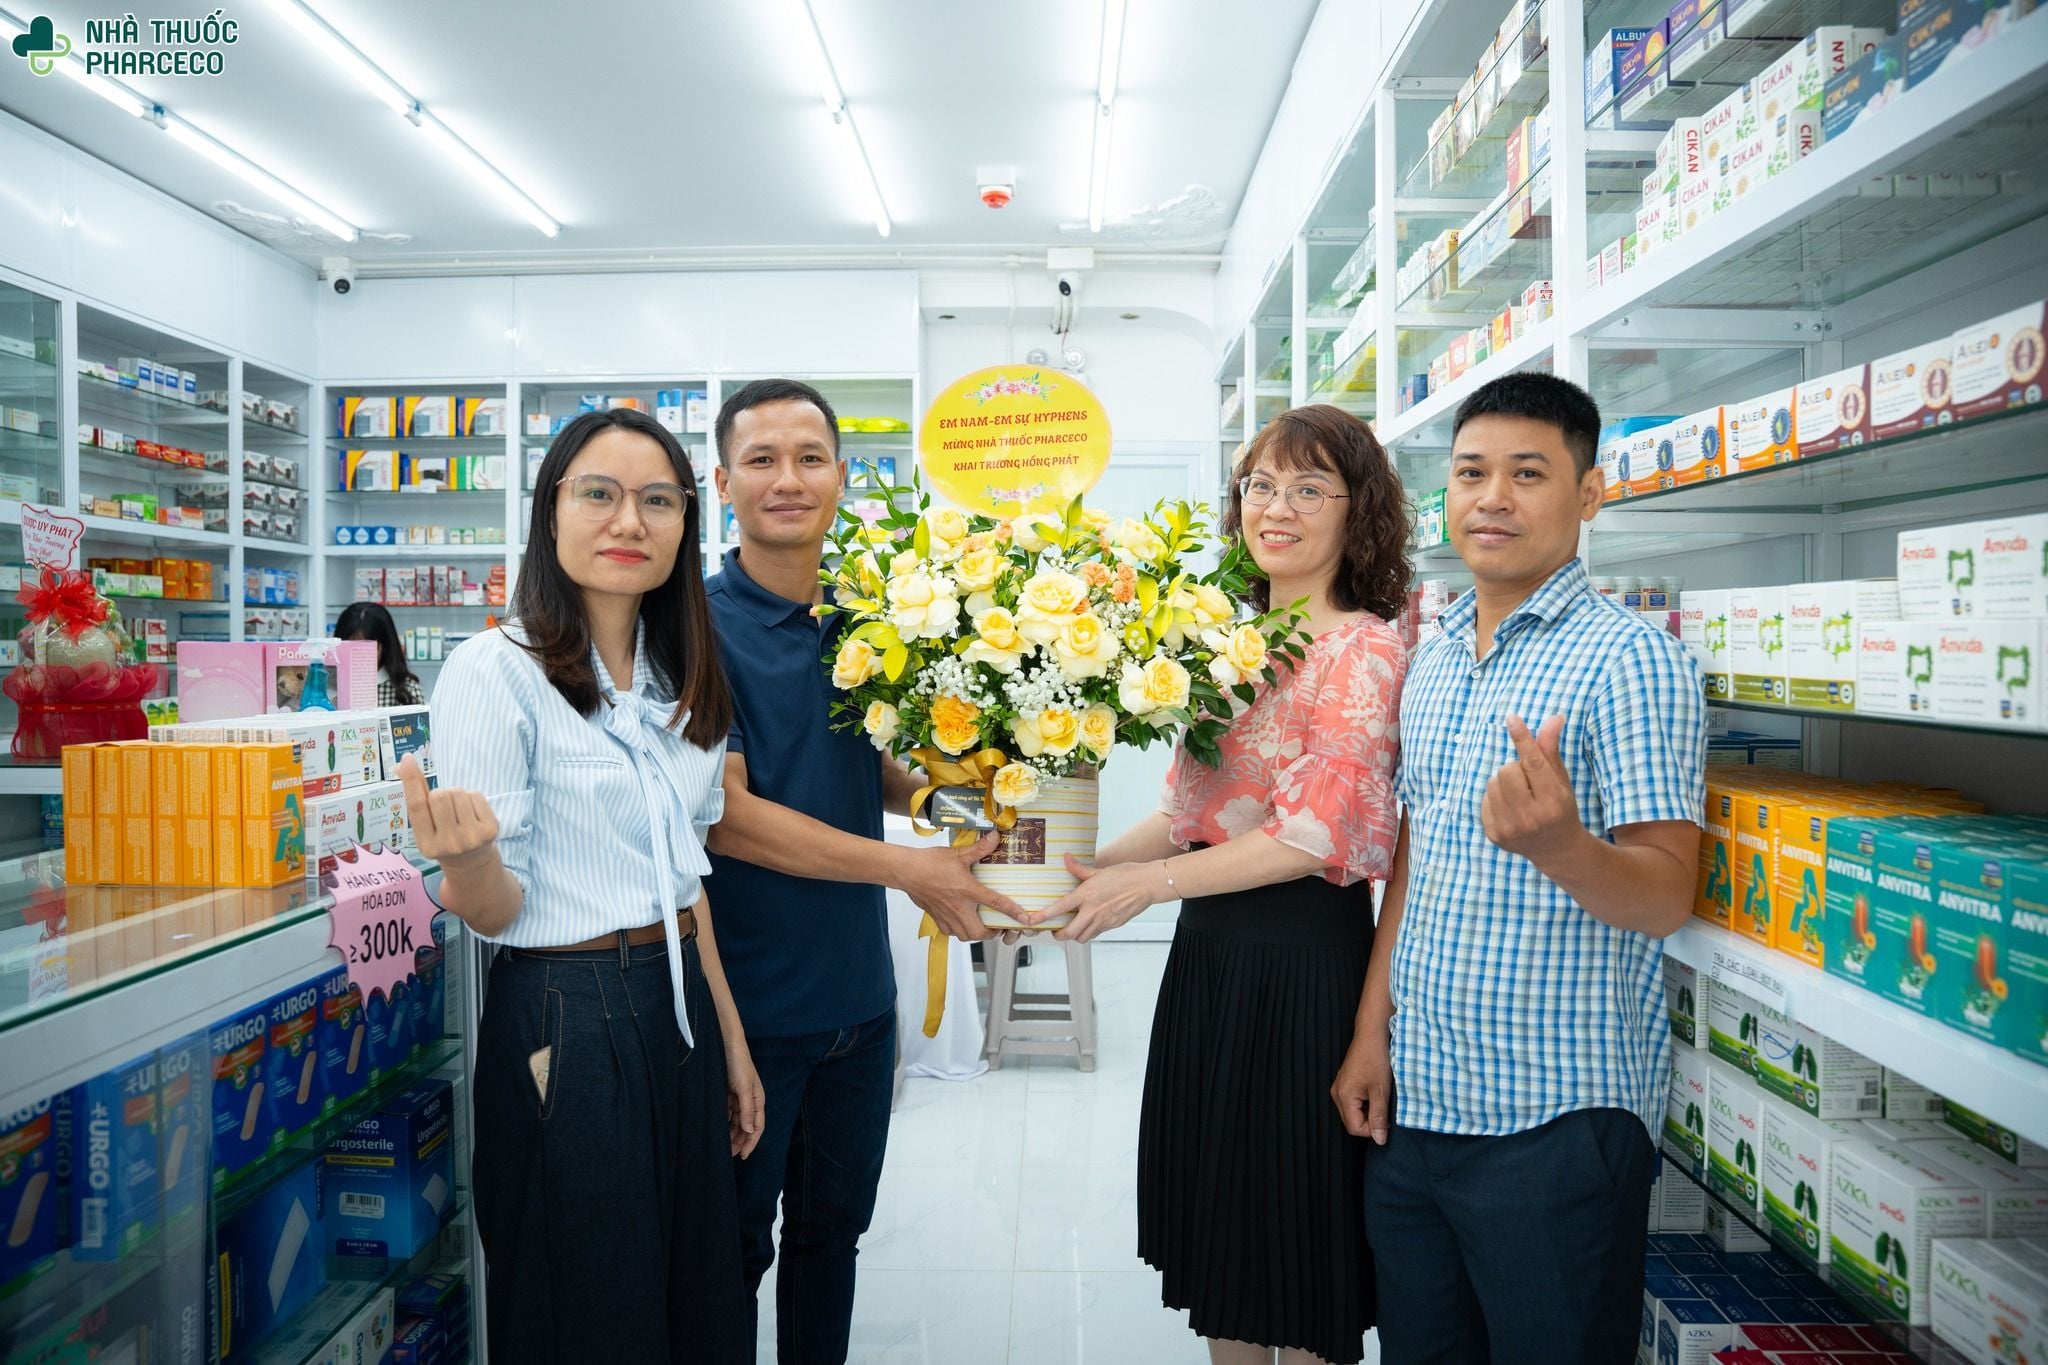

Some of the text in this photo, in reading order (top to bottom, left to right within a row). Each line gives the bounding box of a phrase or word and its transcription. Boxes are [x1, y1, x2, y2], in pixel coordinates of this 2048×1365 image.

[1761, 60, 1793, 93] CIKAN
[1703, 104, 1732, 135] CIKAN
[1687, 130, 1698, 173] CIKAN
[1800, 124, 1812, 157] CIK
[1732, 140, 1763, 169] CIKAN
[1683, 178, 1709, 204] CIKAN
[1638, 208, 1660, 231] CIKAN
[940, 418, 958, 429] EM
[960, 414, 1012, 428] NAM-EM
[1034, 410, 1088, 423] HYPHENS
[976, 437, 997, 448] NHÀ
[999, 433, 1032, 446] THUỐC
[1034, 433, 1088, 445] PHARCECO
[954, 461, 977, 471] KHAI
[1052, 454, 1080, 465] PHÁT
[1682, 608, 1704, 620] Anvida
[1732, 606, 1758, 619] Anvida
[1791, 604, 1821, 618] Anvida
[271, 776, 303, 791] ANVITRA
[321, 808, 346, 826] Anvida
[1736, 831, 1769, 852] ANVITRA
[1781, 843, 1823, 867] ANVITRA
[343, 872, 380, 889] HÀNG
[1827, 857, 1874, 884] ANVITRA
[1877, 872, 1932, 902] ANVITRA
[361, 889, 406, 911] HÓA ĐƠN
[1938, 891, 2003, 923] ANVITRA
[281, 987, 317, 1020] URGO
[223, 1014, 266, 1050] URGO
[1711, 1096, 1733, 1121] AZKA
[89, 1118, 109, 1189] URGO
[1767, 1132, 1793, 1161] AZKA
[1835, 1175, 1873, 1209] AZKA
[1687, 1329, 1713, 1337] AZKA
